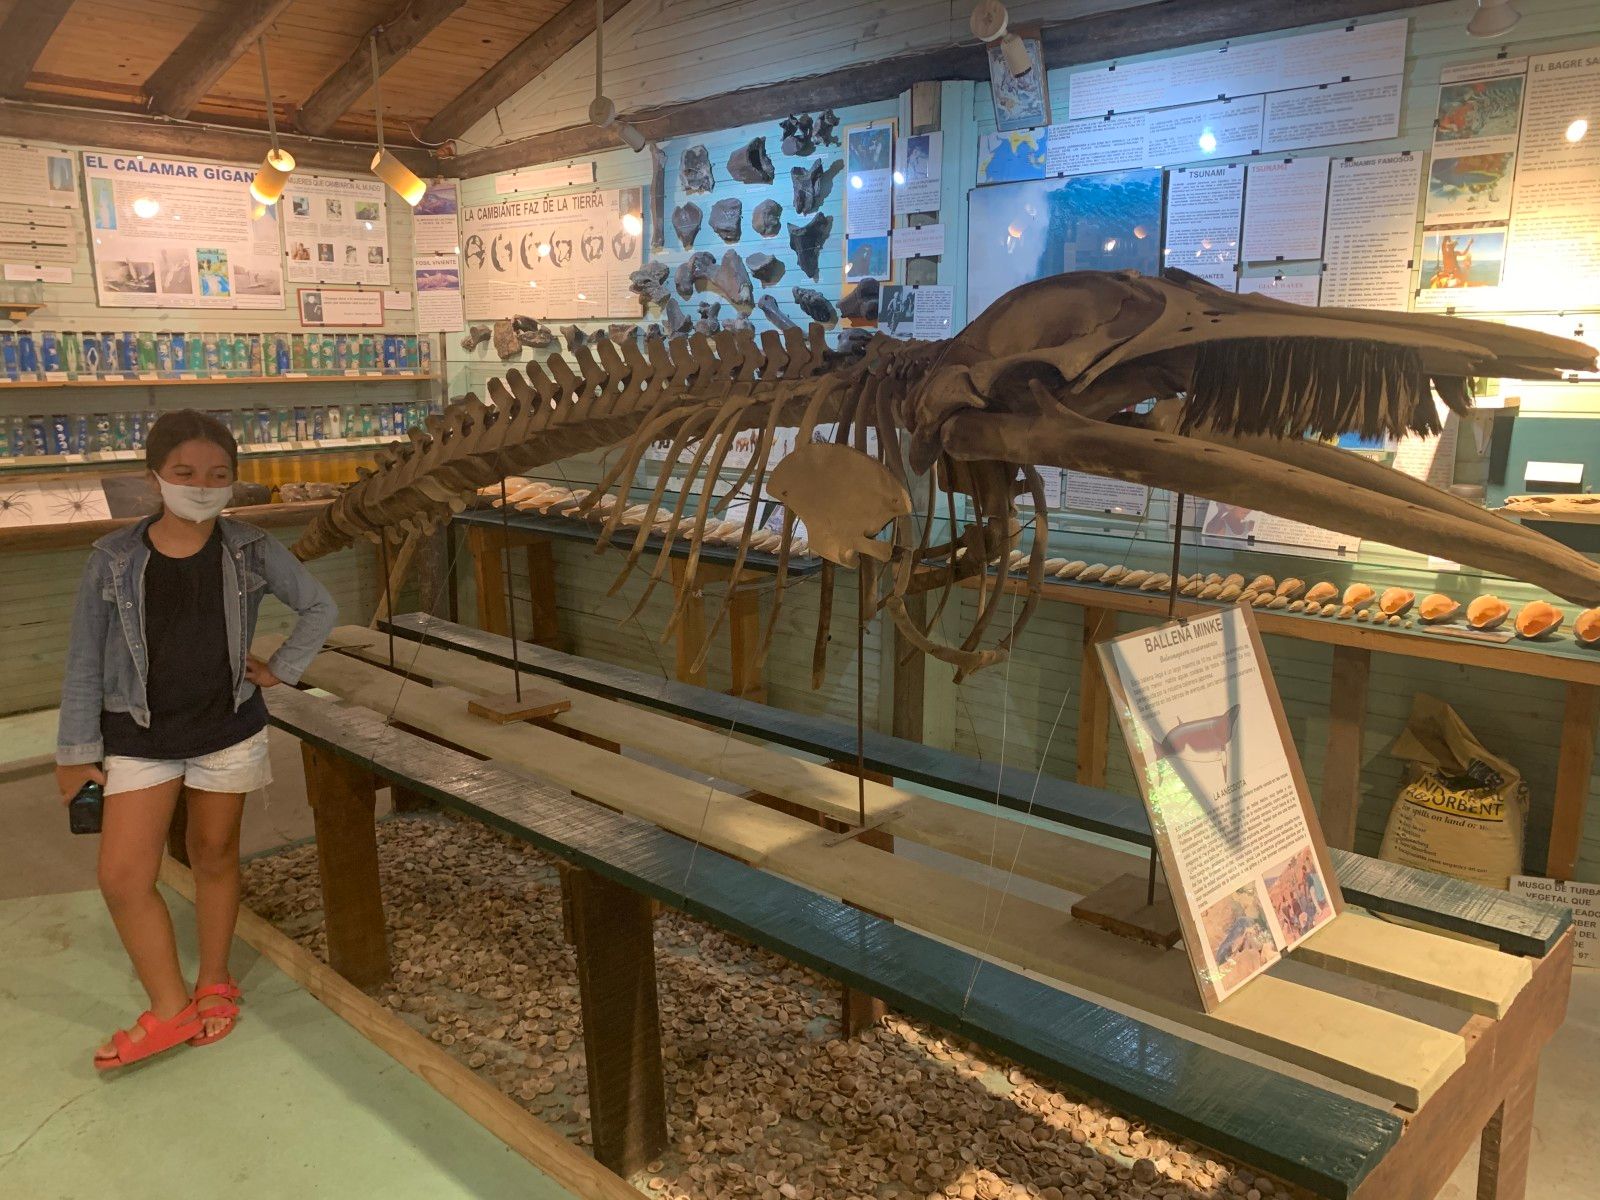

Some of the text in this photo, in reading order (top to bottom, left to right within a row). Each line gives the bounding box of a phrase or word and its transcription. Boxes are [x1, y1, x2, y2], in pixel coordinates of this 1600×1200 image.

[1534, 64, 1545, 72] EL
[1548, 58, 1582, 71] BAGRE
[1340, 155, 1414, 168] TSUNAMIS FAMOSOS
[85, 155, 256, 183] EL CALAMAR GIGAN
[1189, 169, 1226, 178] TSUNAMI
[464, 194, 604, 222] LA CAMBIANTE FAZ DE LA TIERRA
[1144, 617, 1224, 653] BALLENA MINKE
[1412, 808, 1430, 818] spills
[1444, 815, 1465, 827] land
[1518, 880, 1600, 896] MUSGO DE TURBA
[1526, 892, 1591, 906] VEGETAL QUE
[1574, 908, 1600, 918] EADO
[1579, 931, 1597, 939] DEL
